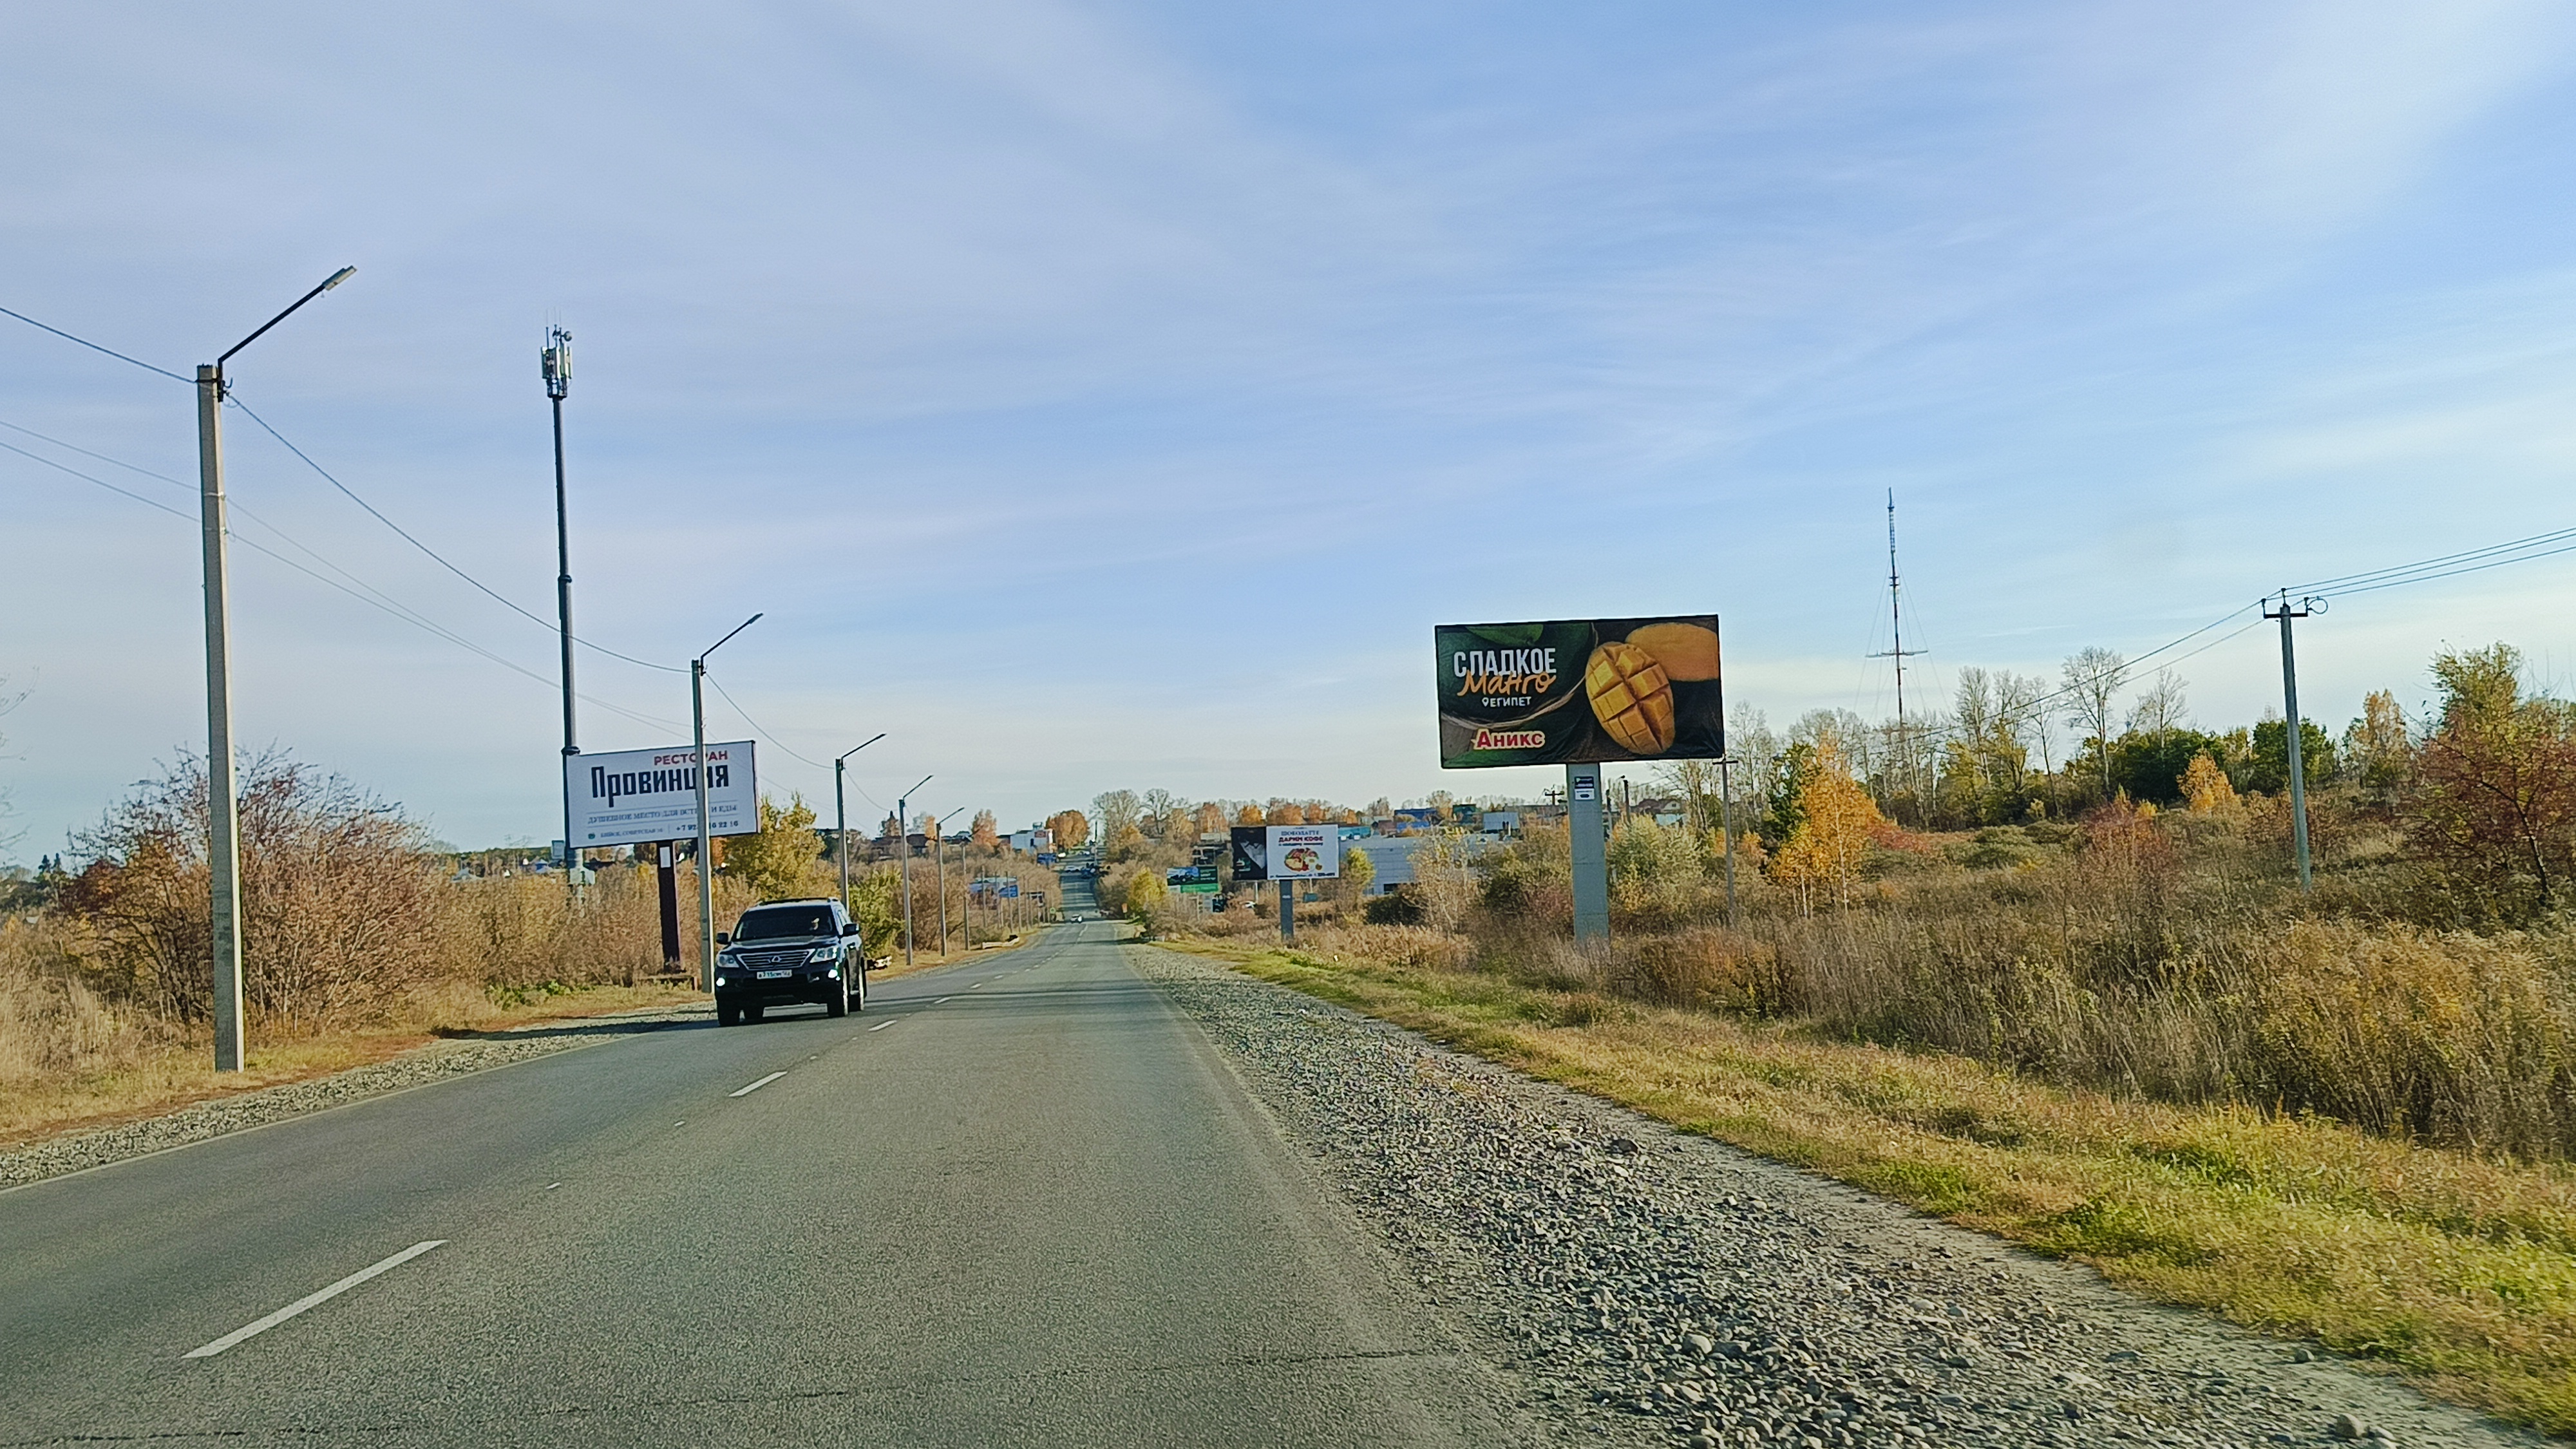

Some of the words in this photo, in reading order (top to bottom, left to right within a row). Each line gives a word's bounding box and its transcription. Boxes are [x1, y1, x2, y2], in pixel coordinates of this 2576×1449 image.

[1454, 648, 1557, 677] СЛАДКОЕ
[1457, 670, 1557, 696] Манго
[1490, 697, 1531, 707] ЕГИПЕТ
[654, 750, 728, 766] РЕСТОАН
[634, 811, 661, 819] МЕСТО
